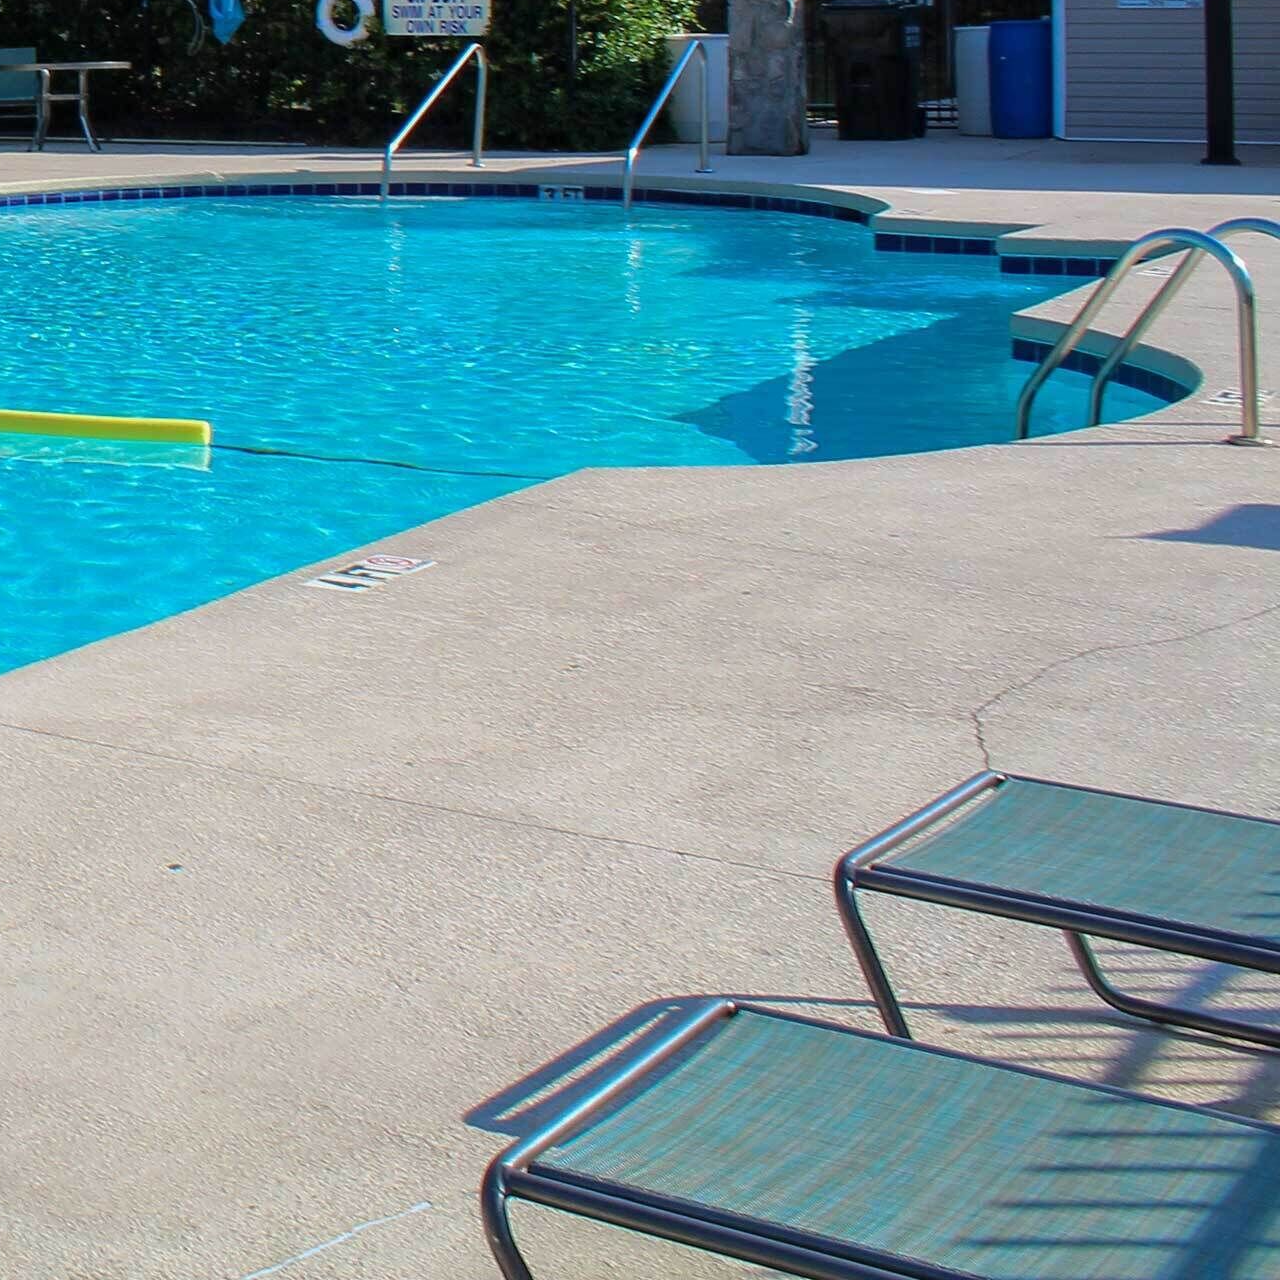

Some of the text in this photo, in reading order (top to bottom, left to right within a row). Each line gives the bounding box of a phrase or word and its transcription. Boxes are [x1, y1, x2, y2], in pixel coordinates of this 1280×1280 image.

[392, 5, 482, 19] SWIM AT YOUR
[407, 20, 468, 34] OWN RISK
